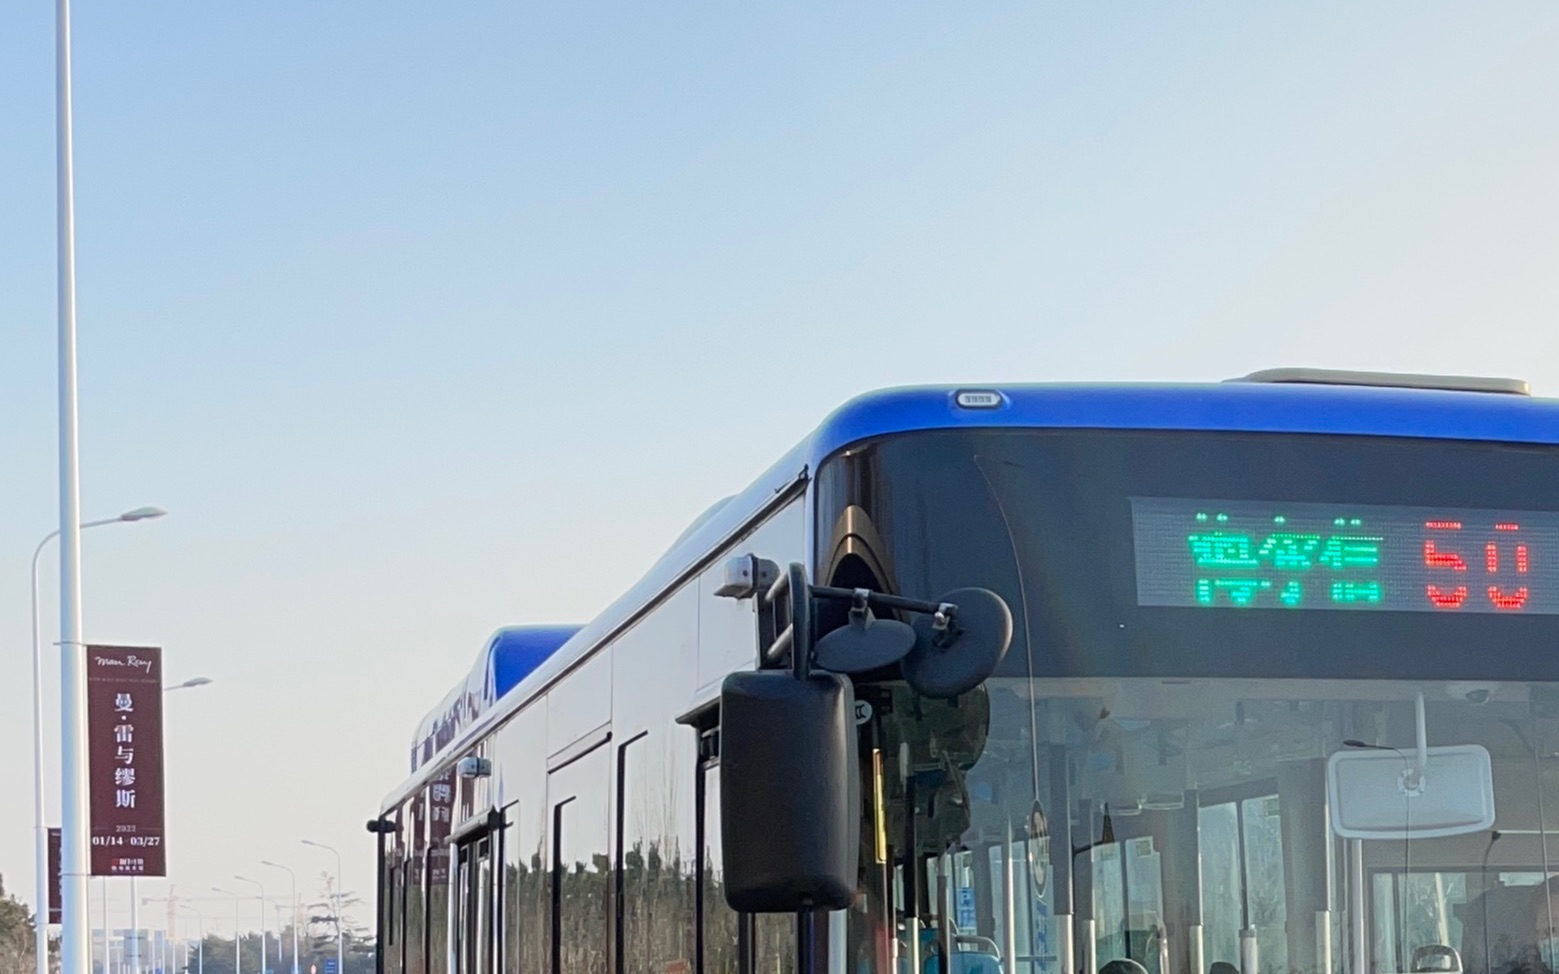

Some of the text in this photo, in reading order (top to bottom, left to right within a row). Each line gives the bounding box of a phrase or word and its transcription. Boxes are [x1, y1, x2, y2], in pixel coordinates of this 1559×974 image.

[1424, 520, 1529, 609] 50
[92, 835, 161, 847] 01/14 03/27
